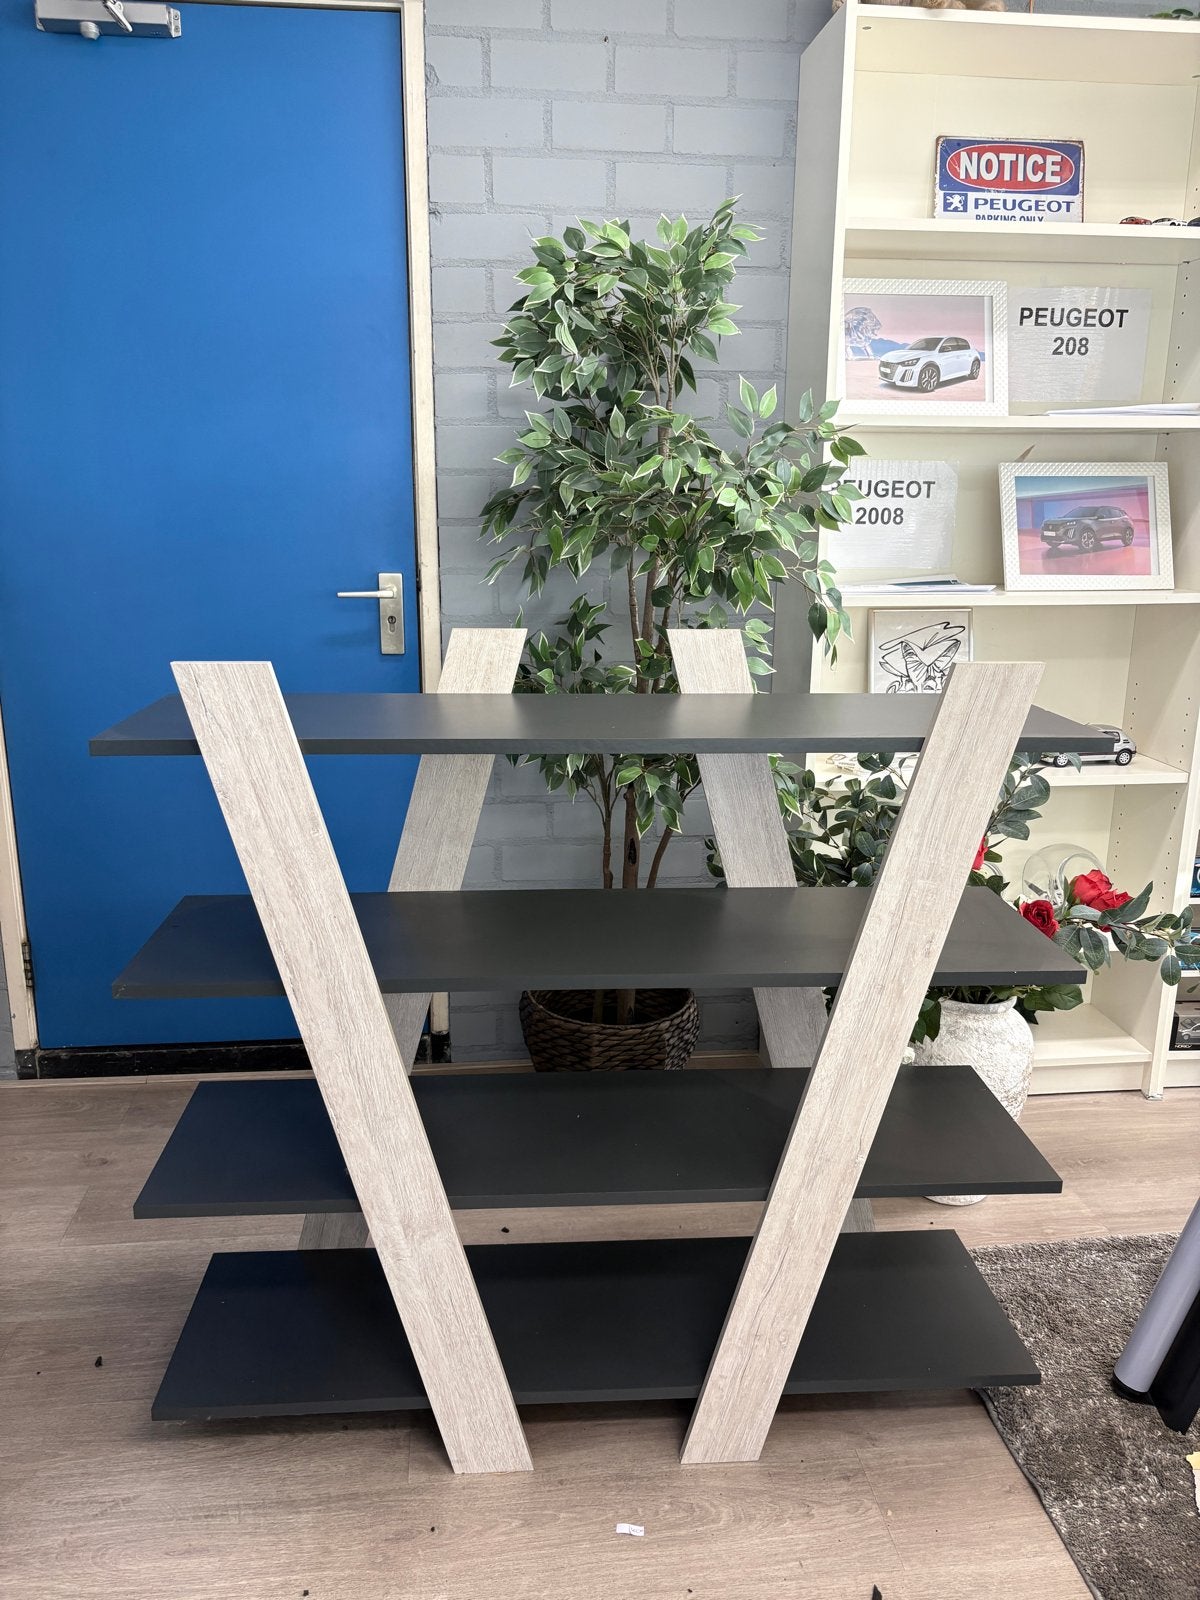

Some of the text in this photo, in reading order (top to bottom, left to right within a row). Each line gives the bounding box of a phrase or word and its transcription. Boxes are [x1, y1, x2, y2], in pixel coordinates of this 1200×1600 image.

[960, 151, 1062, 183] NOTICE
[974, 197, 1075, 213] PEUGEOT
[1019, 307, 1129, 328] PEUGEOT
[1052, 336, 1089, 356] 208
[831, 480, 936, 499] UGEOT
[855, 507, 904, 525] 2008
